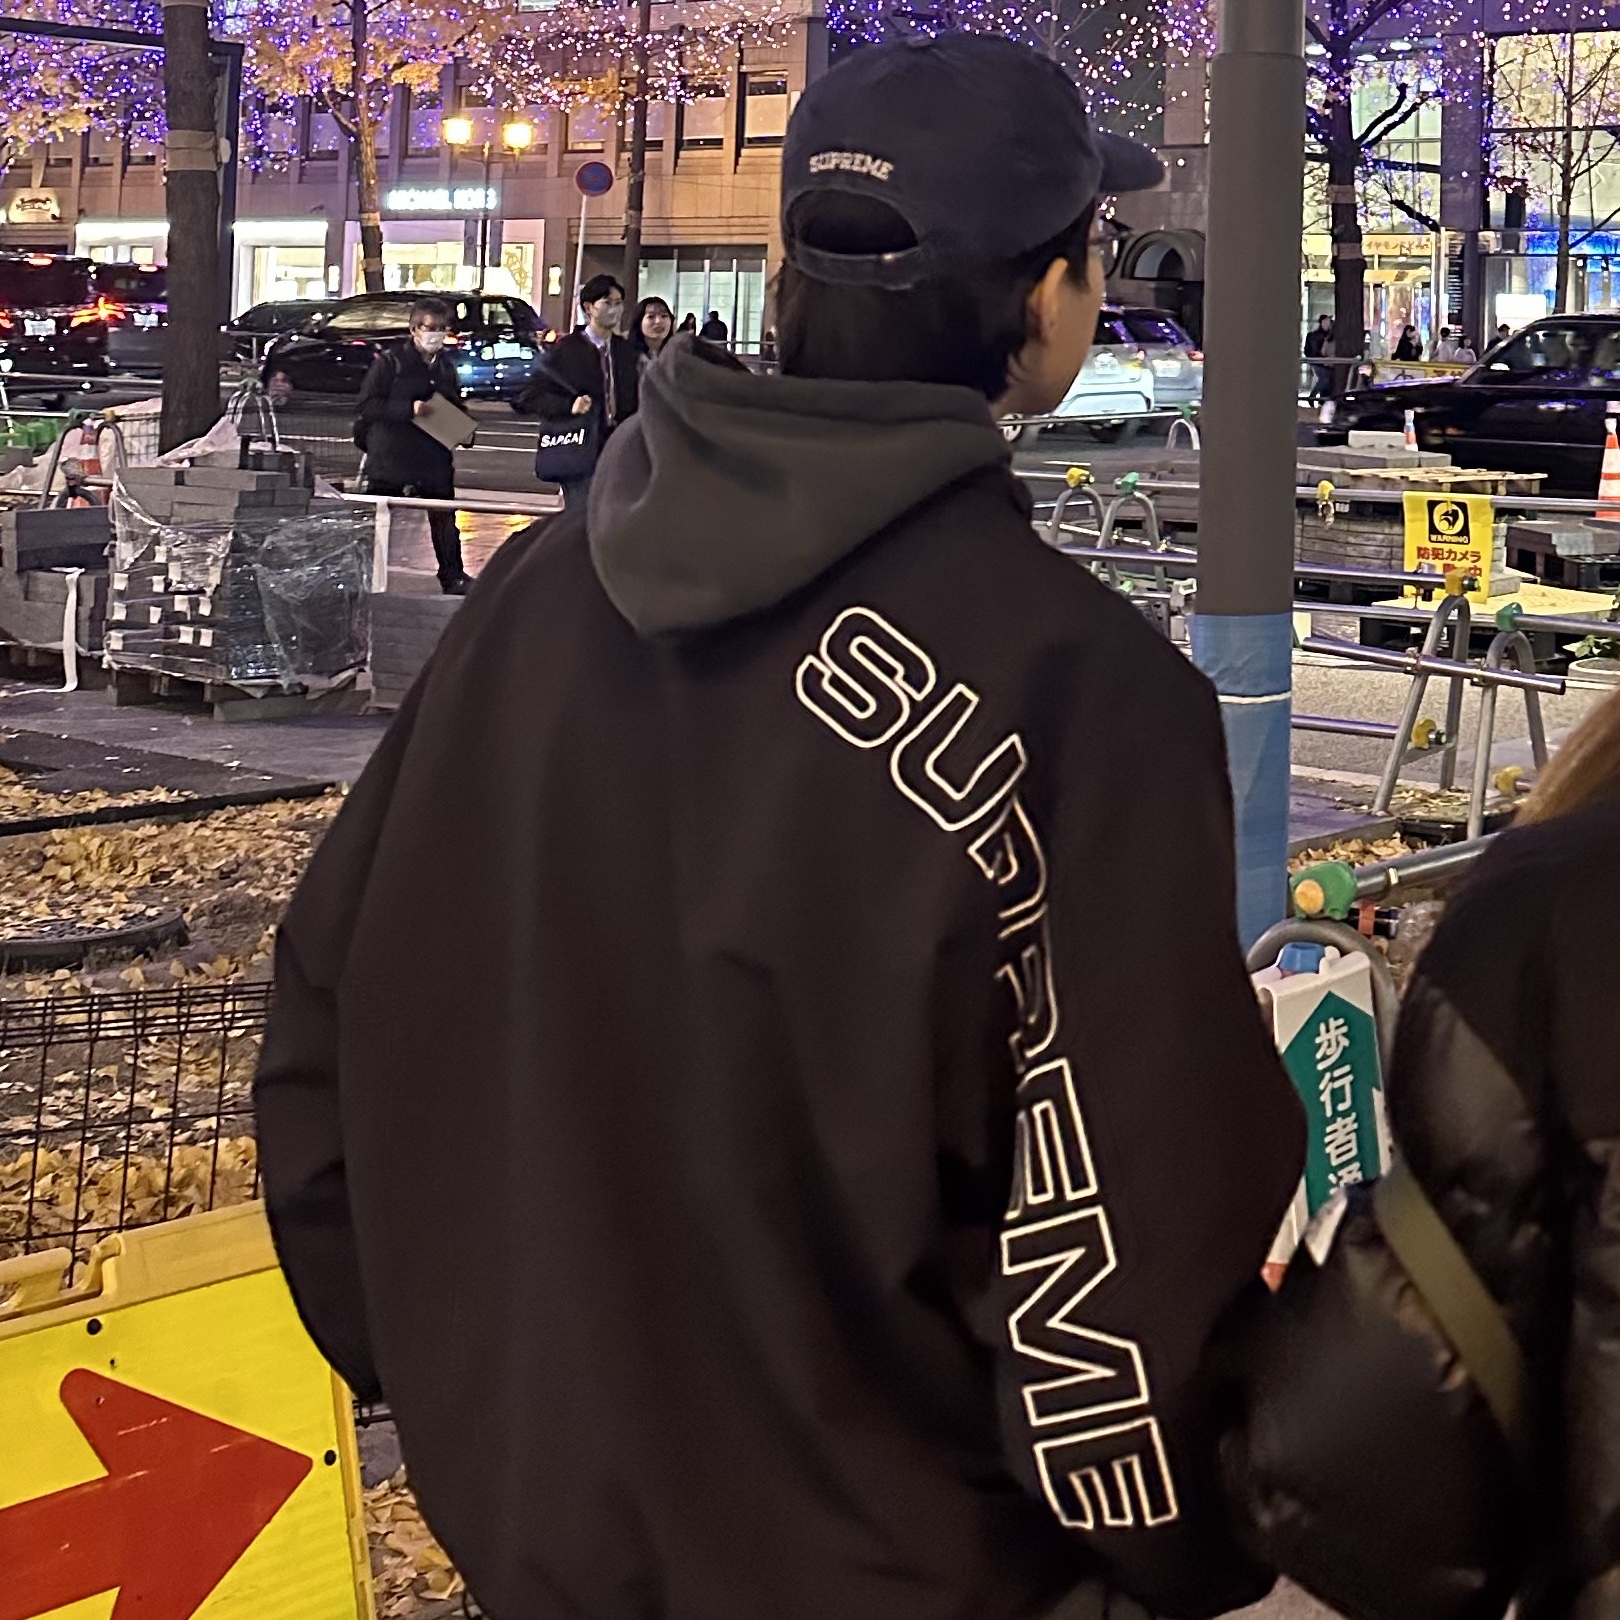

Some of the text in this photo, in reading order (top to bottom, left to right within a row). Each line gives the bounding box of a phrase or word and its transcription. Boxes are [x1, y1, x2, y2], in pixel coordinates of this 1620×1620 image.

[809, 151, 894, 180] SUPREME
[1430, 533, 1469, 544] WARNING
[1416, 546, 1482, 563] 防犯カメラ
